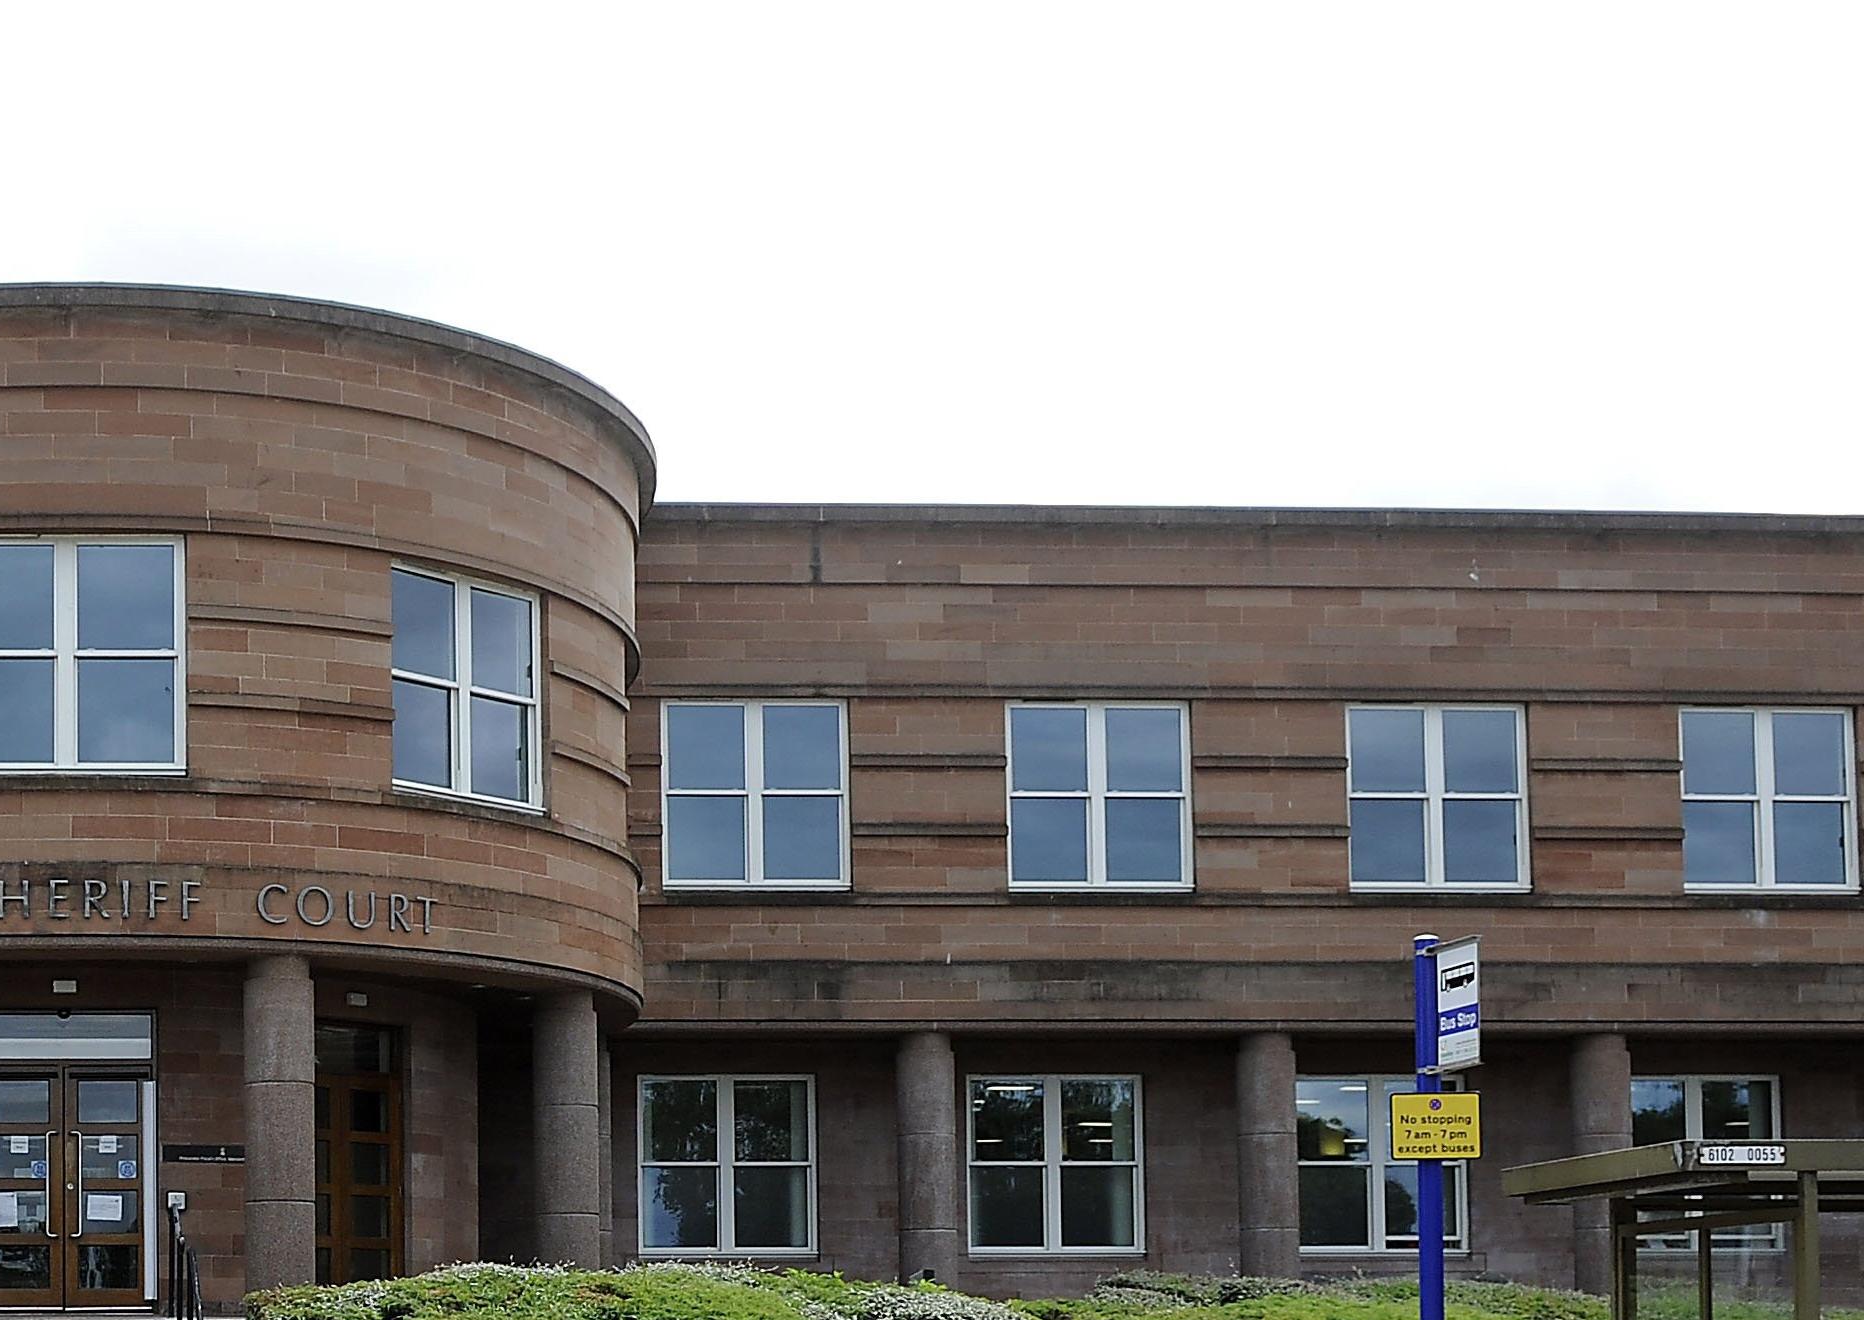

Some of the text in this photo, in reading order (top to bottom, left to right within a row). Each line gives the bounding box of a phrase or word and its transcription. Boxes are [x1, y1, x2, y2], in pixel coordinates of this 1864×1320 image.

[257, 884, 438, 934] COURT
[1440, 1012, 1476, 1031] Bus Stop
[1400, 1115, 1472, 1127] No stopping
[1414, 1131, 1431, 1139] am
[1449, 1132, 1468, 1141] pm
[1398, 1143, 1475, 1155] except buses
[1708, 1147, 1777, 1161] 6102 0055
